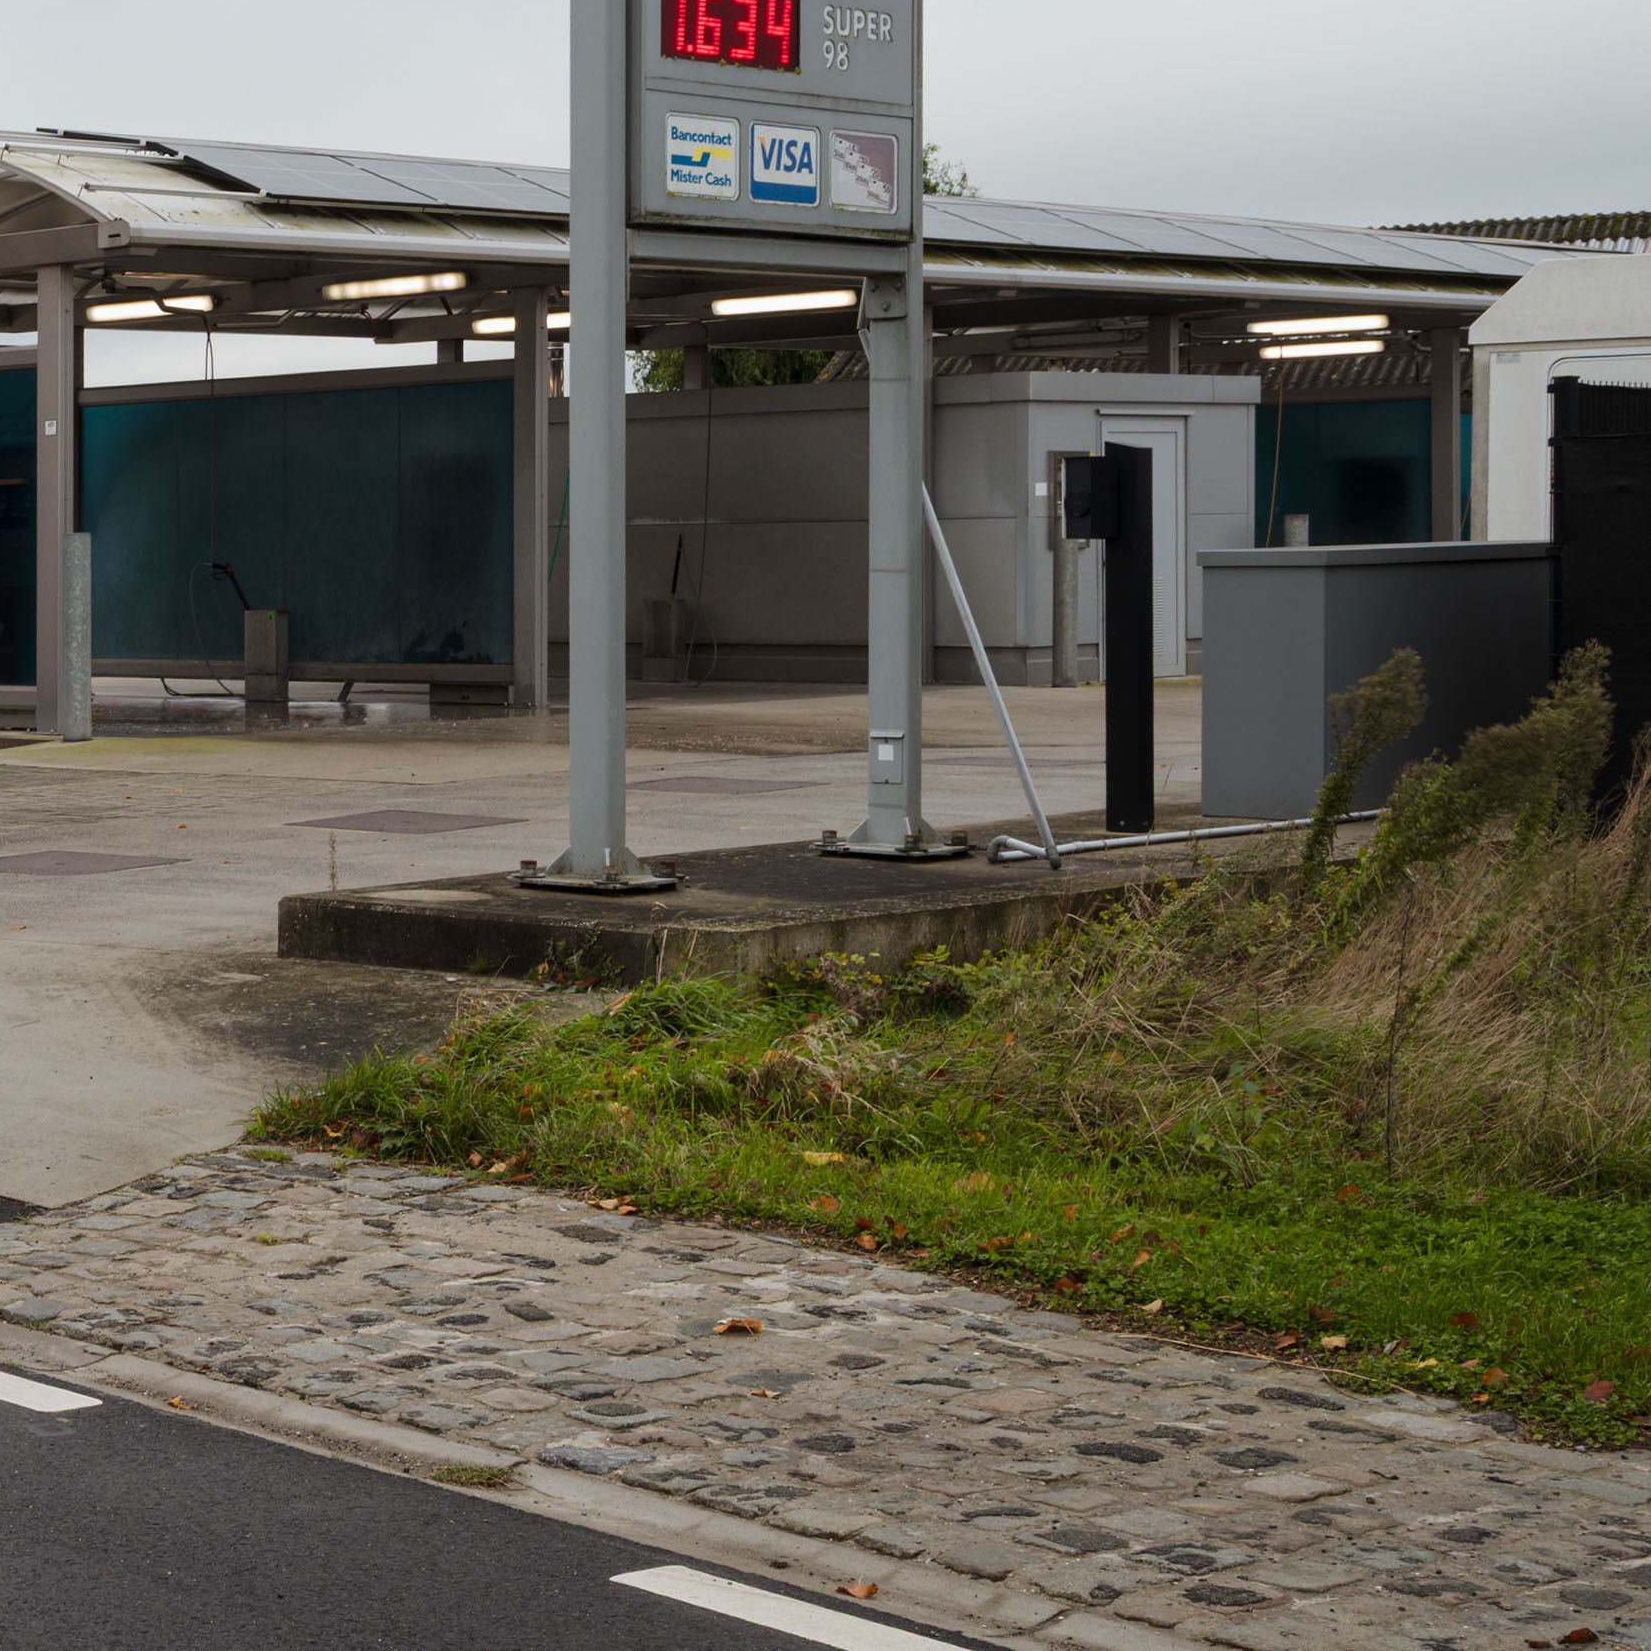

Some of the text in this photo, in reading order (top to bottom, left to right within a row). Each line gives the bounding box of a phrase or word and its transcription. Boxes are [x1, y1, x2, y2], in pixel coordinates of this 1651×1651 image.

[823, 4, 893, 42] SUPER
[823, 39, 849, 71] 98
[671, 126, 732, 146] Bancontact
[757, 137, 814, 174] VISA
[671, 169, 732, 187] Mister Cash
